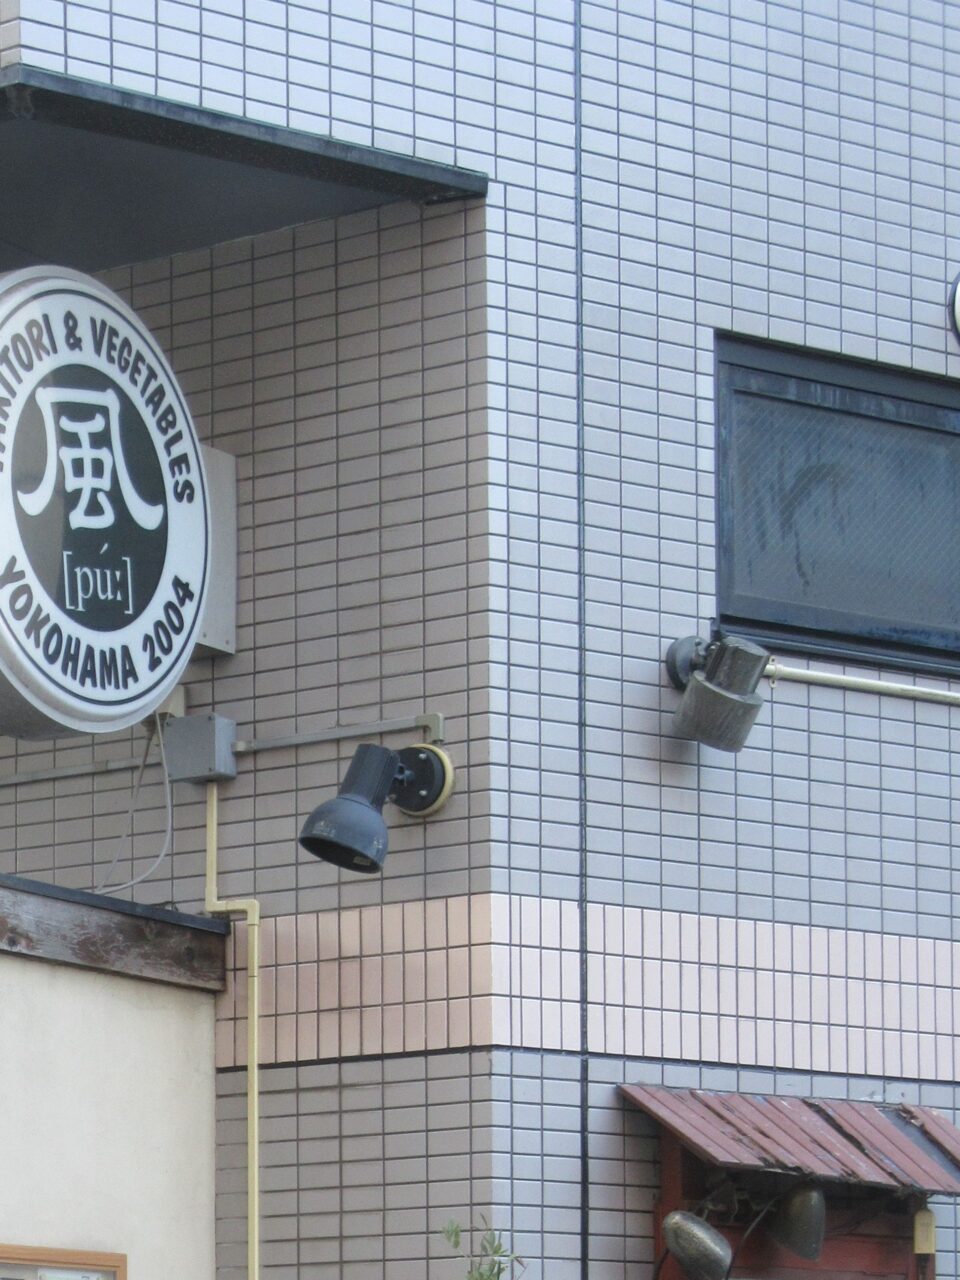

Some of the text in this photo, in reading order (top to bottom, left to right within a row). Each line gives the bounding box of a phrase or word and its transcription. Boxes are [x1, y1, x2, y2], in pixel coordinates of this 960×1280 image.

[16, 387, 164, 531] 風
[64, 310, 84, 351] &
[90, 315, 196, 506] VEGETABLES
[141, 574, 196, 668] 2004
